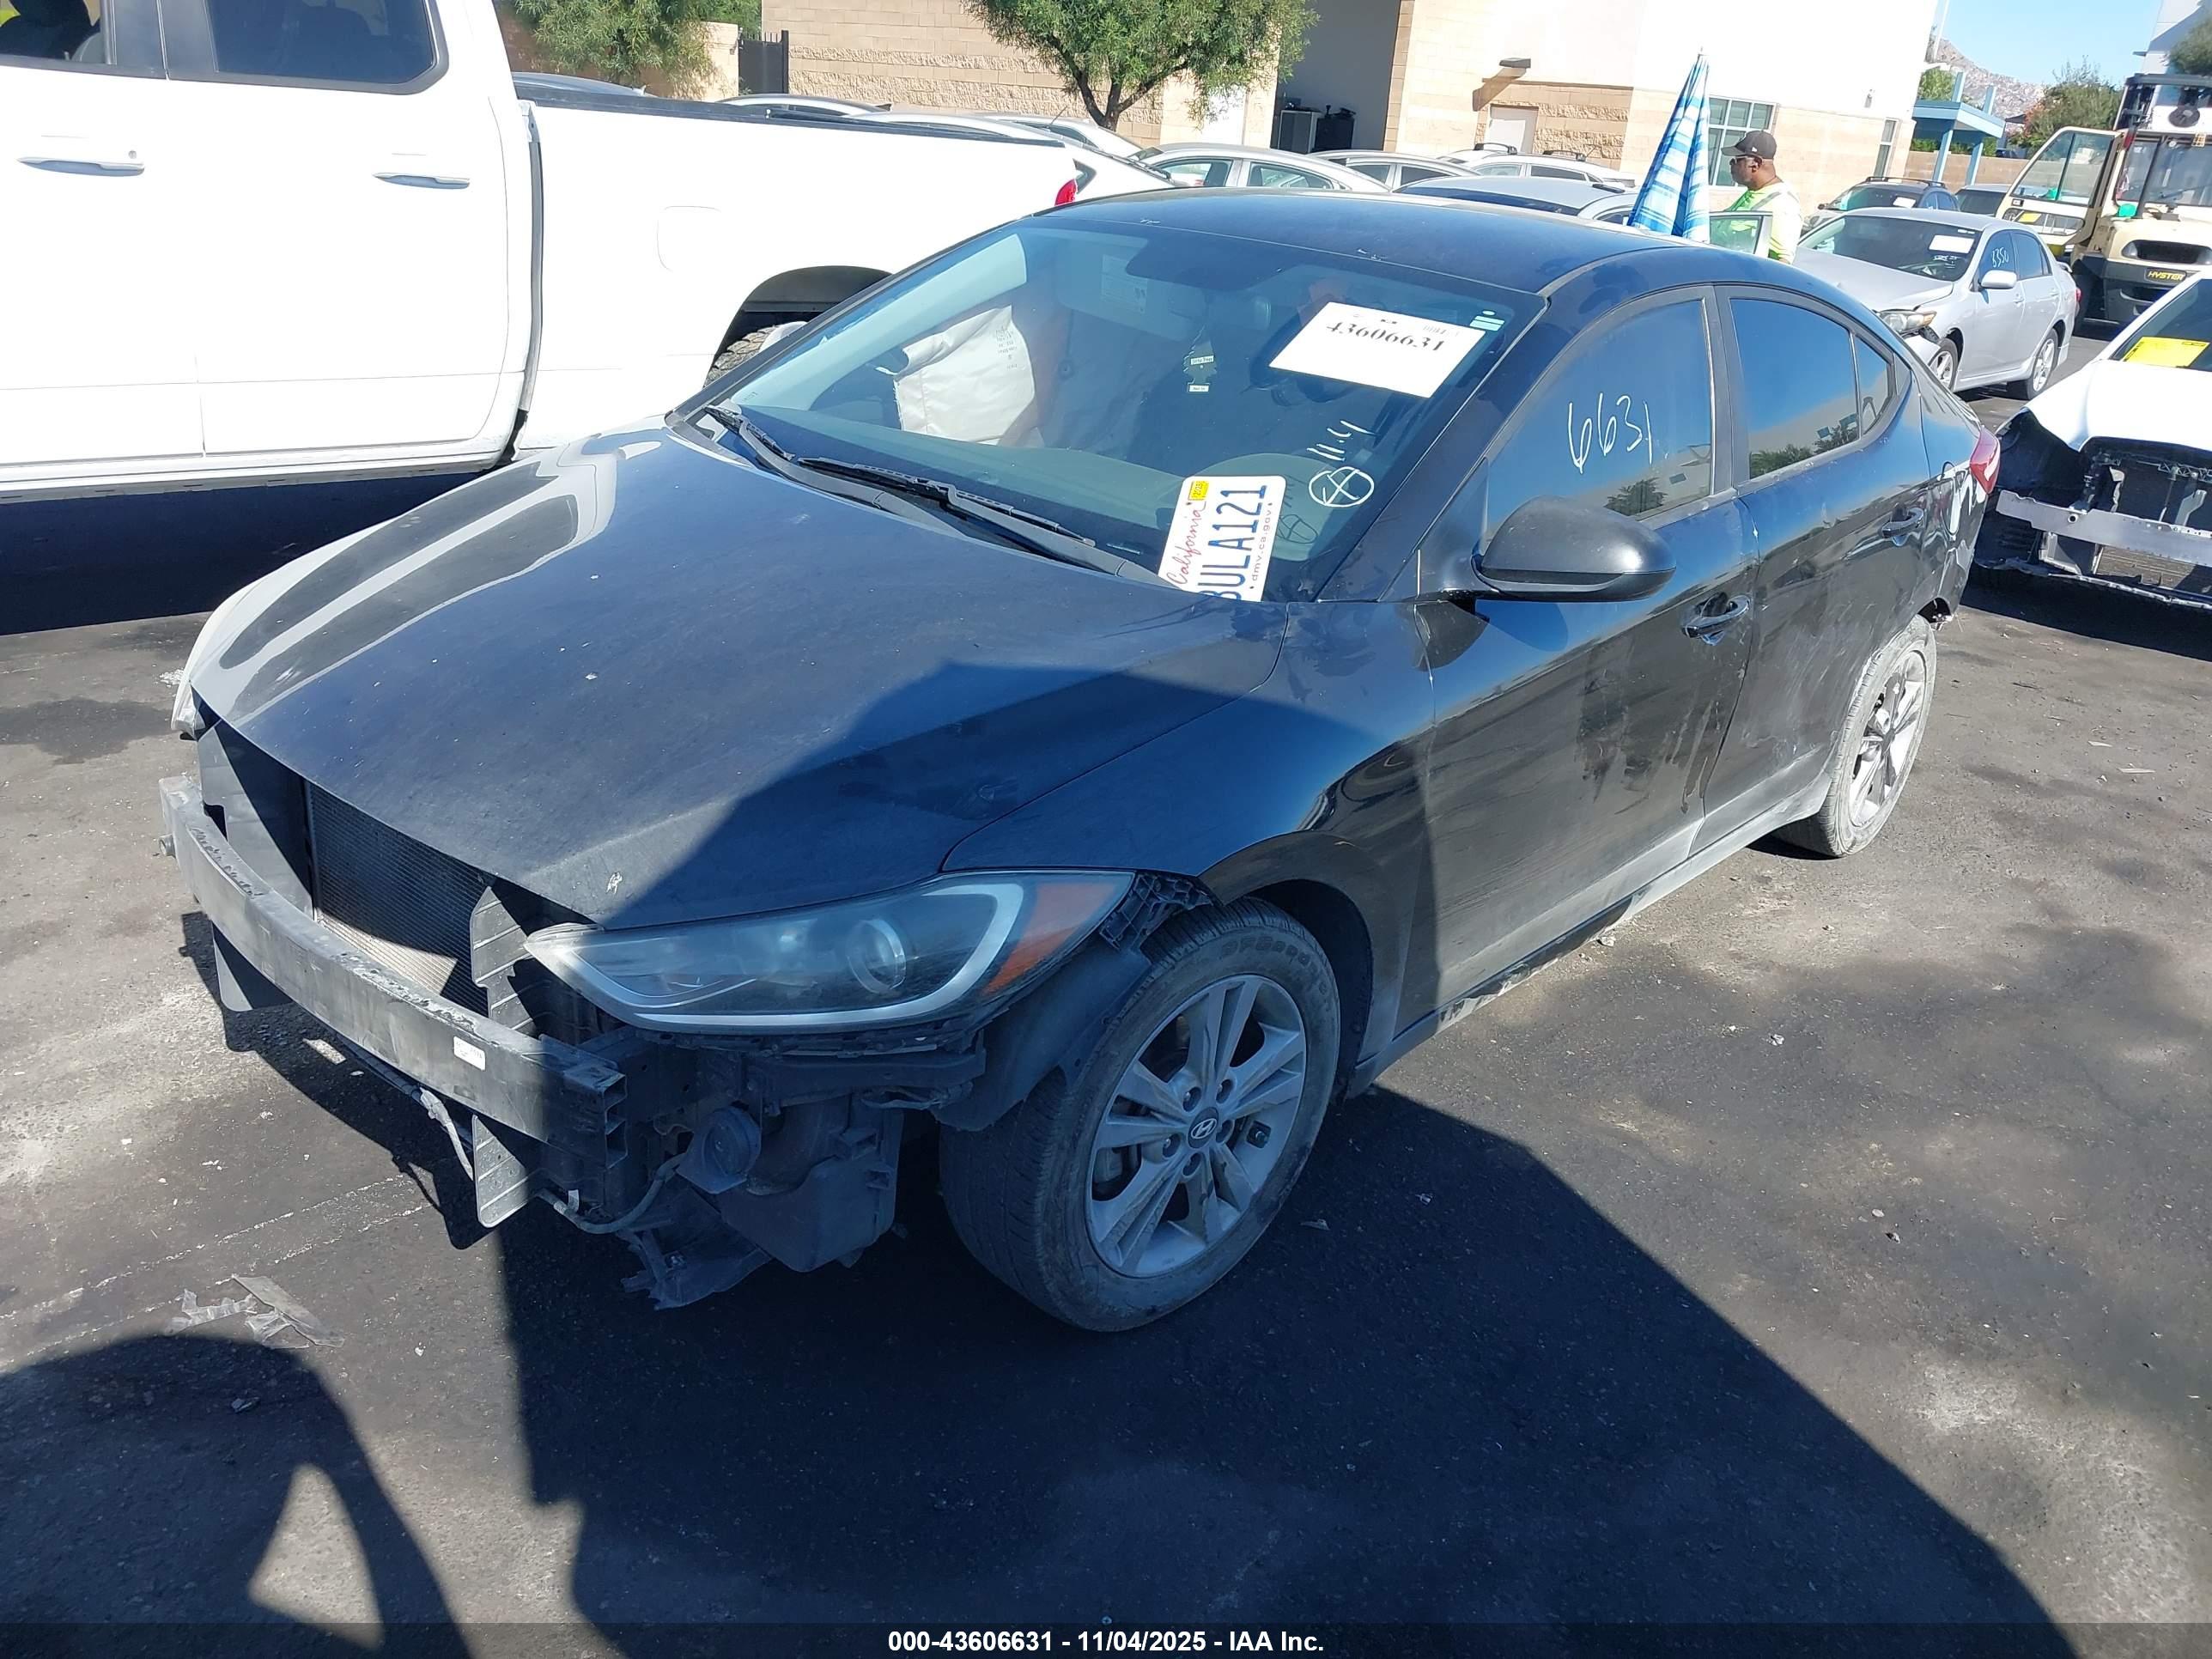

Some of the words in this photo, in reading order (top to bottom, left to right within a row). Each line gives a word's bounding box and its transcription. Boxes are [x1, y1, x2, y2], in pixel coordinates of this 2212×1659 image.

[1327, 322, 1444, 351] 43606631
[1568, 392, 1652, 474] 6631
[1166, 501, 1206, 585] California
[1252, 509, 1273, 581] dmv.ca.gov
